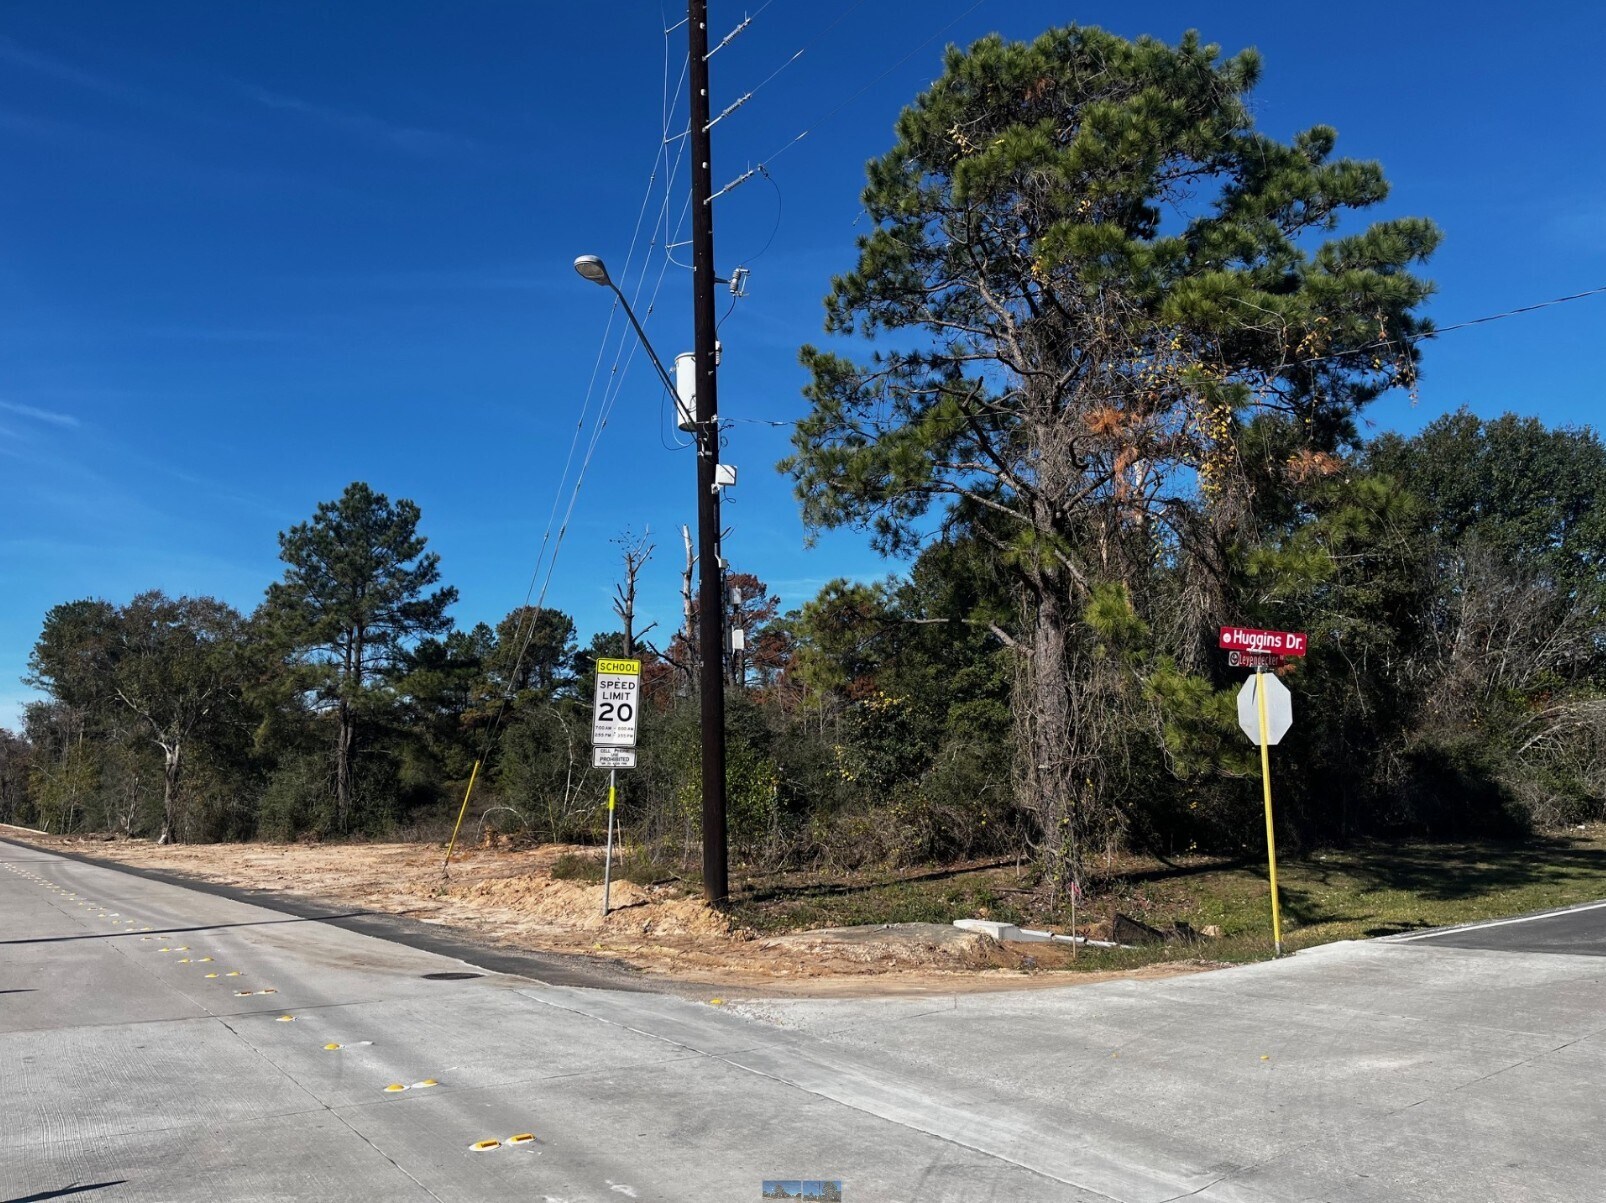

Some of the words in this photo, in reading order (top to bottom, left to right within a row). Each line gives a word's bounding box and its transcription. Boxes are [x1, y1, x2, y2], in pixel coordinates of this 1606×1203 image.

[1233, 629, 1282, 650] Huggins
[1286, 633, 1303, 650] Dr.
[600, 662, 637, 672] SCHOOL
[600, 680, 636, 690] SPEED
[602, 691, 631, 700] LIMIT
[598, 702, 633, 722] 20
